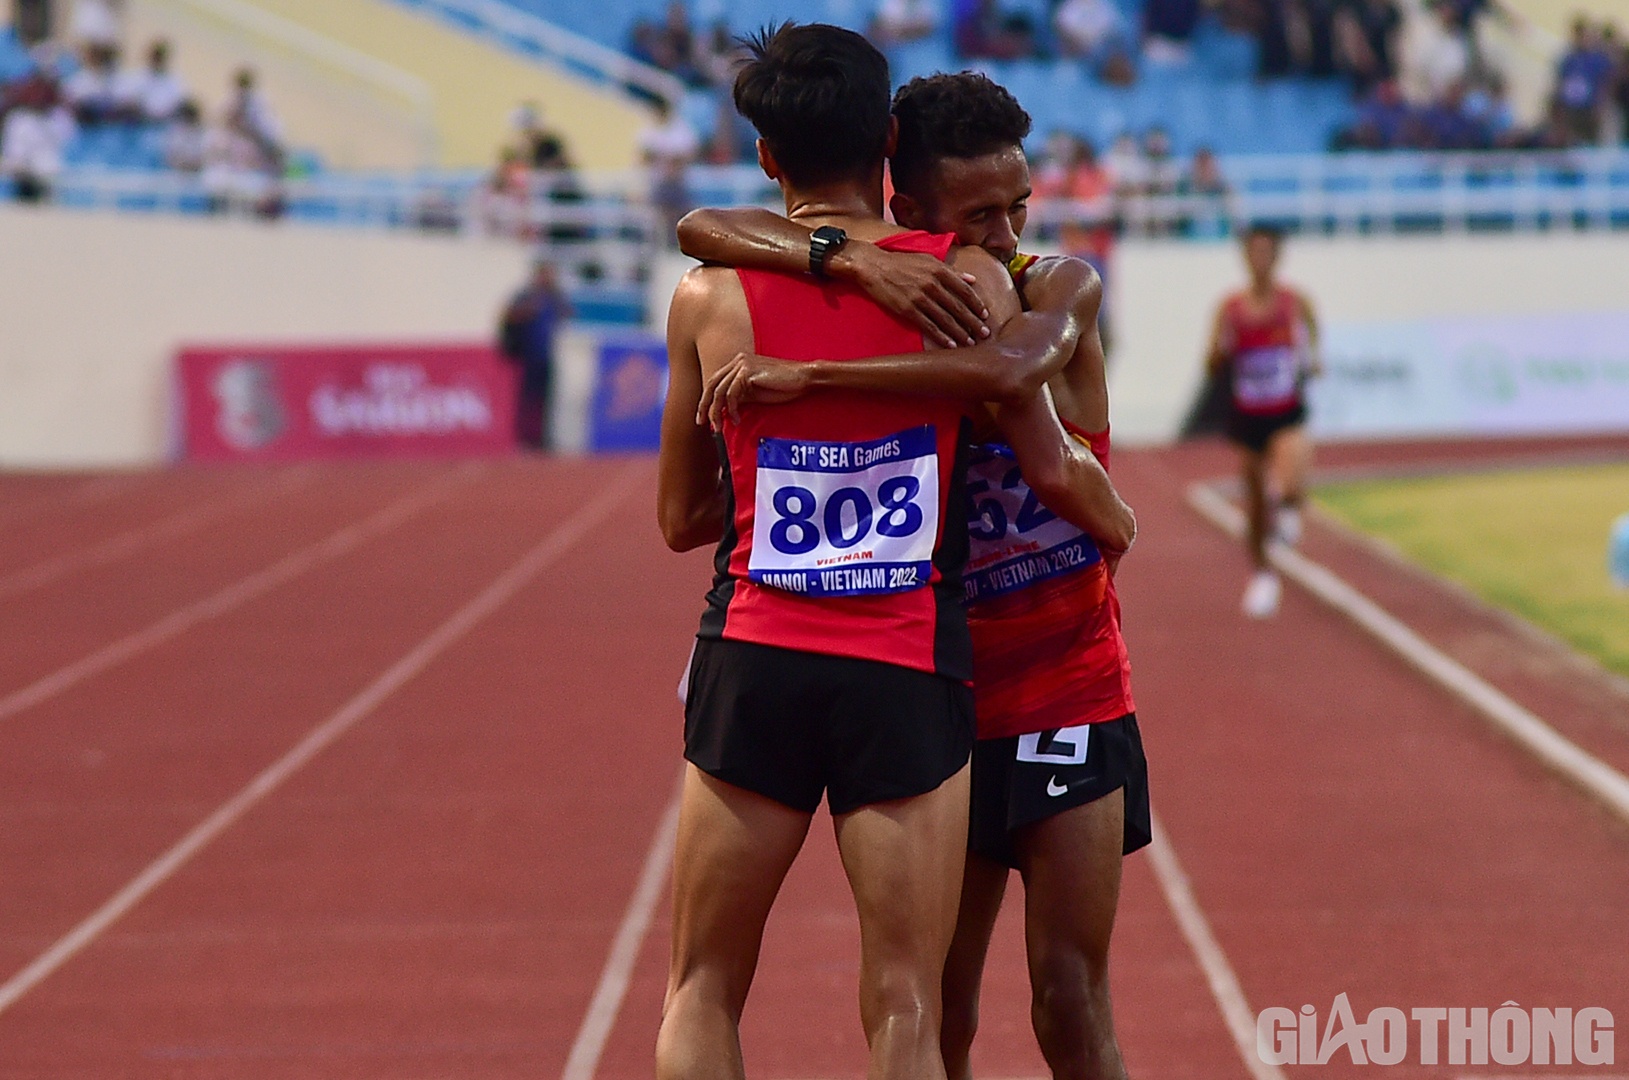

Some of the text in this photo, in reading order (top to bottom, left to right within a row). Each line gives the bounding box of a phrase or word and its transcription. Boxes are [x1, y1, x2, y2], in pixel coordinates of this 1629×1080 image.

[818, 446, 849, 468] SEA
[853, 440, 901, 467] Games
[769, 475, 923, 555] 808
[816, 551, 873, 566] VIETNAM
[988, 556, 1051, 591] VIETNAM
[1053, 544, 1086, 571] 2022
[820, 567, 885, 591] VIETNAM
[889, 567, 918, 588] 2022
